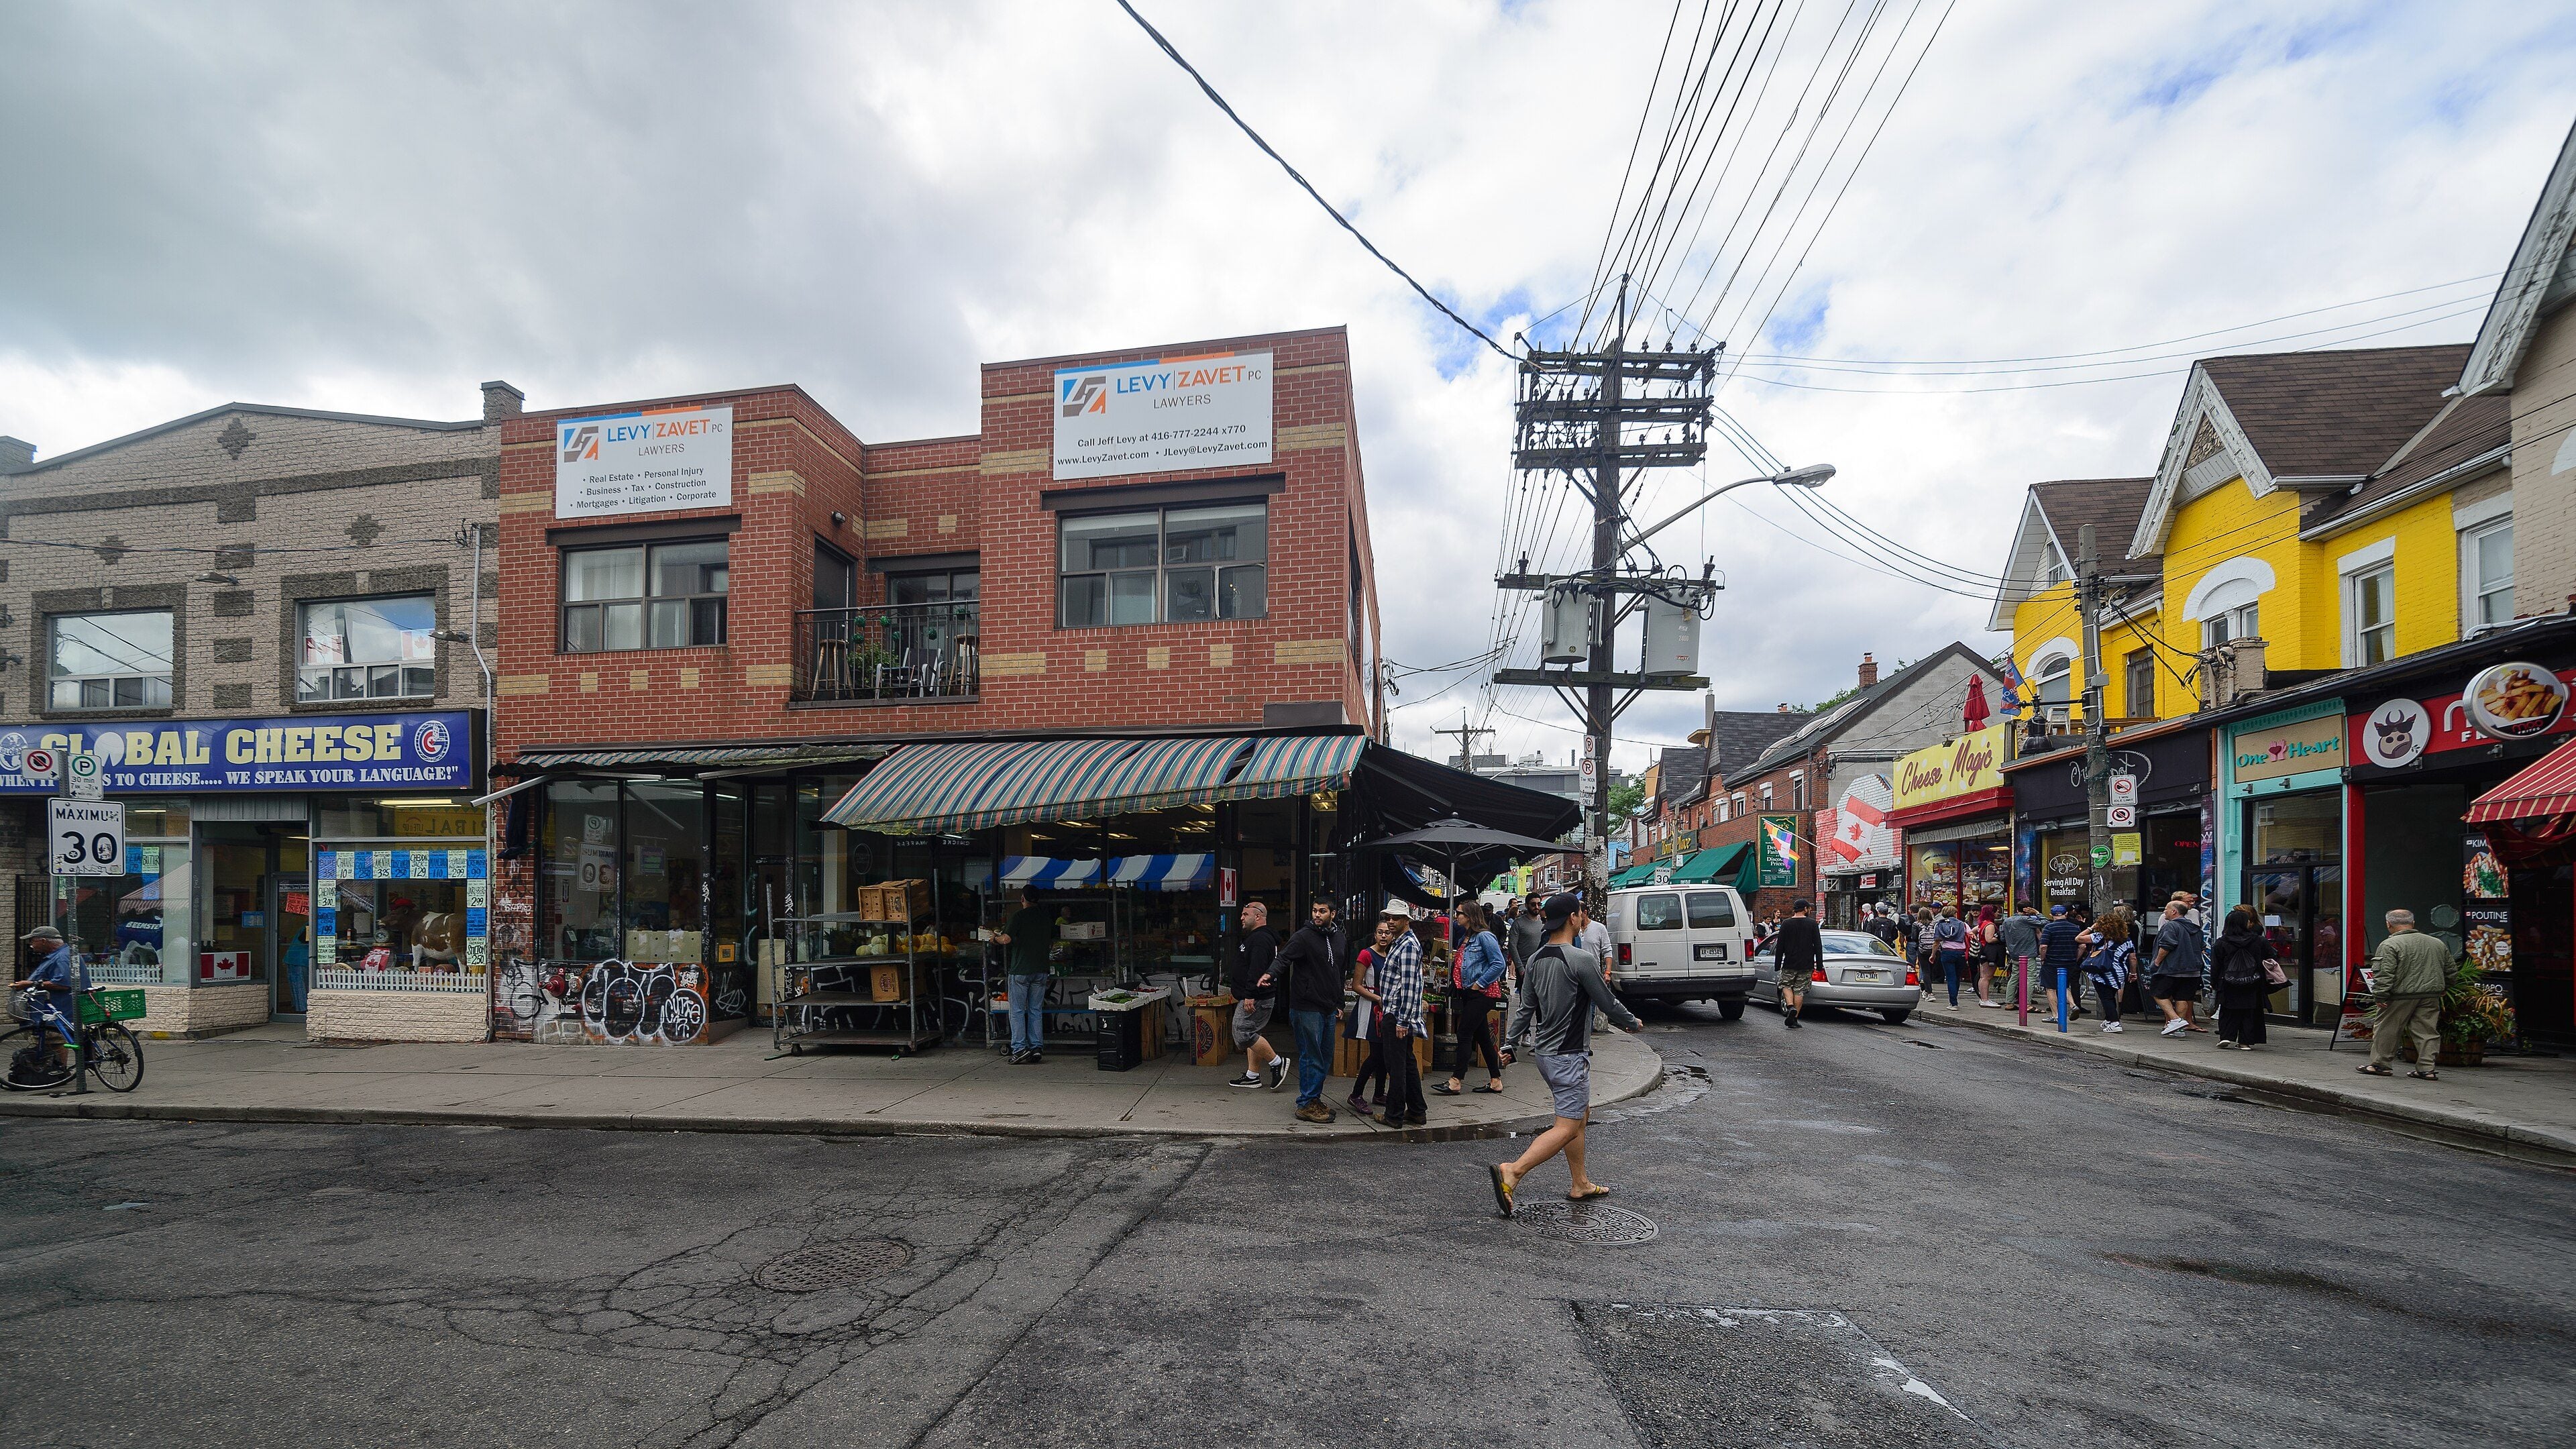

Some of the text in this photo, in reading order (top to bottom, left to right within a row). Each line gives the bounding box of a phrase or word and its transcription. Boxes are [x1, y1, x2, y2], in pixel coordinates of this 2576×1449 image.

[1117, 365, 1261, 394] LEVY ZAVET PC
[1153, 394, 1211, 409] LAWYERS
[607, 419, 722, 443] LEVY ZAVET PC
[1077, 425, 1246, 447] Call Jeff Levy at 416-777-2244 x770
[639, 443, 684, 456] LAWYERS
[1057, 440, 1267, 466] www.LevyZavet.com JLevy@LevyZavet.com
[590, 468, 704, 484] Real Estate Personal Injury
[586, 479, 706, 496] Business Tax Construction
[577, 490, 716, 509] Mortgages Litigation Corporate
[2518, 727, 2540, 735] FRITES
[40, 724, 401, 767] GLOBAL CHEESE
[2237, 736, 2339, 767] One Heart
[1901, 739, 1992, 796] Cheese Magic
[115, 773, 135, 786] TO
[227, 772, 250, 784] WE
[255, 770, 306, 784] SPEAK
[309, 769, 356, 784] YOUR
[61, 831, 117, 864] 30
[2174, 840, 2199, 848] OPEN
[1656, 875, 1669, 883] 30
[2043, 877, 2084, 888] Serving All Day
[2051, 888, 2076, 896] Breakfast
[2471, 911, 2508, 920] POUTINE
[125, 921, 161, 930] BEEMSTE
